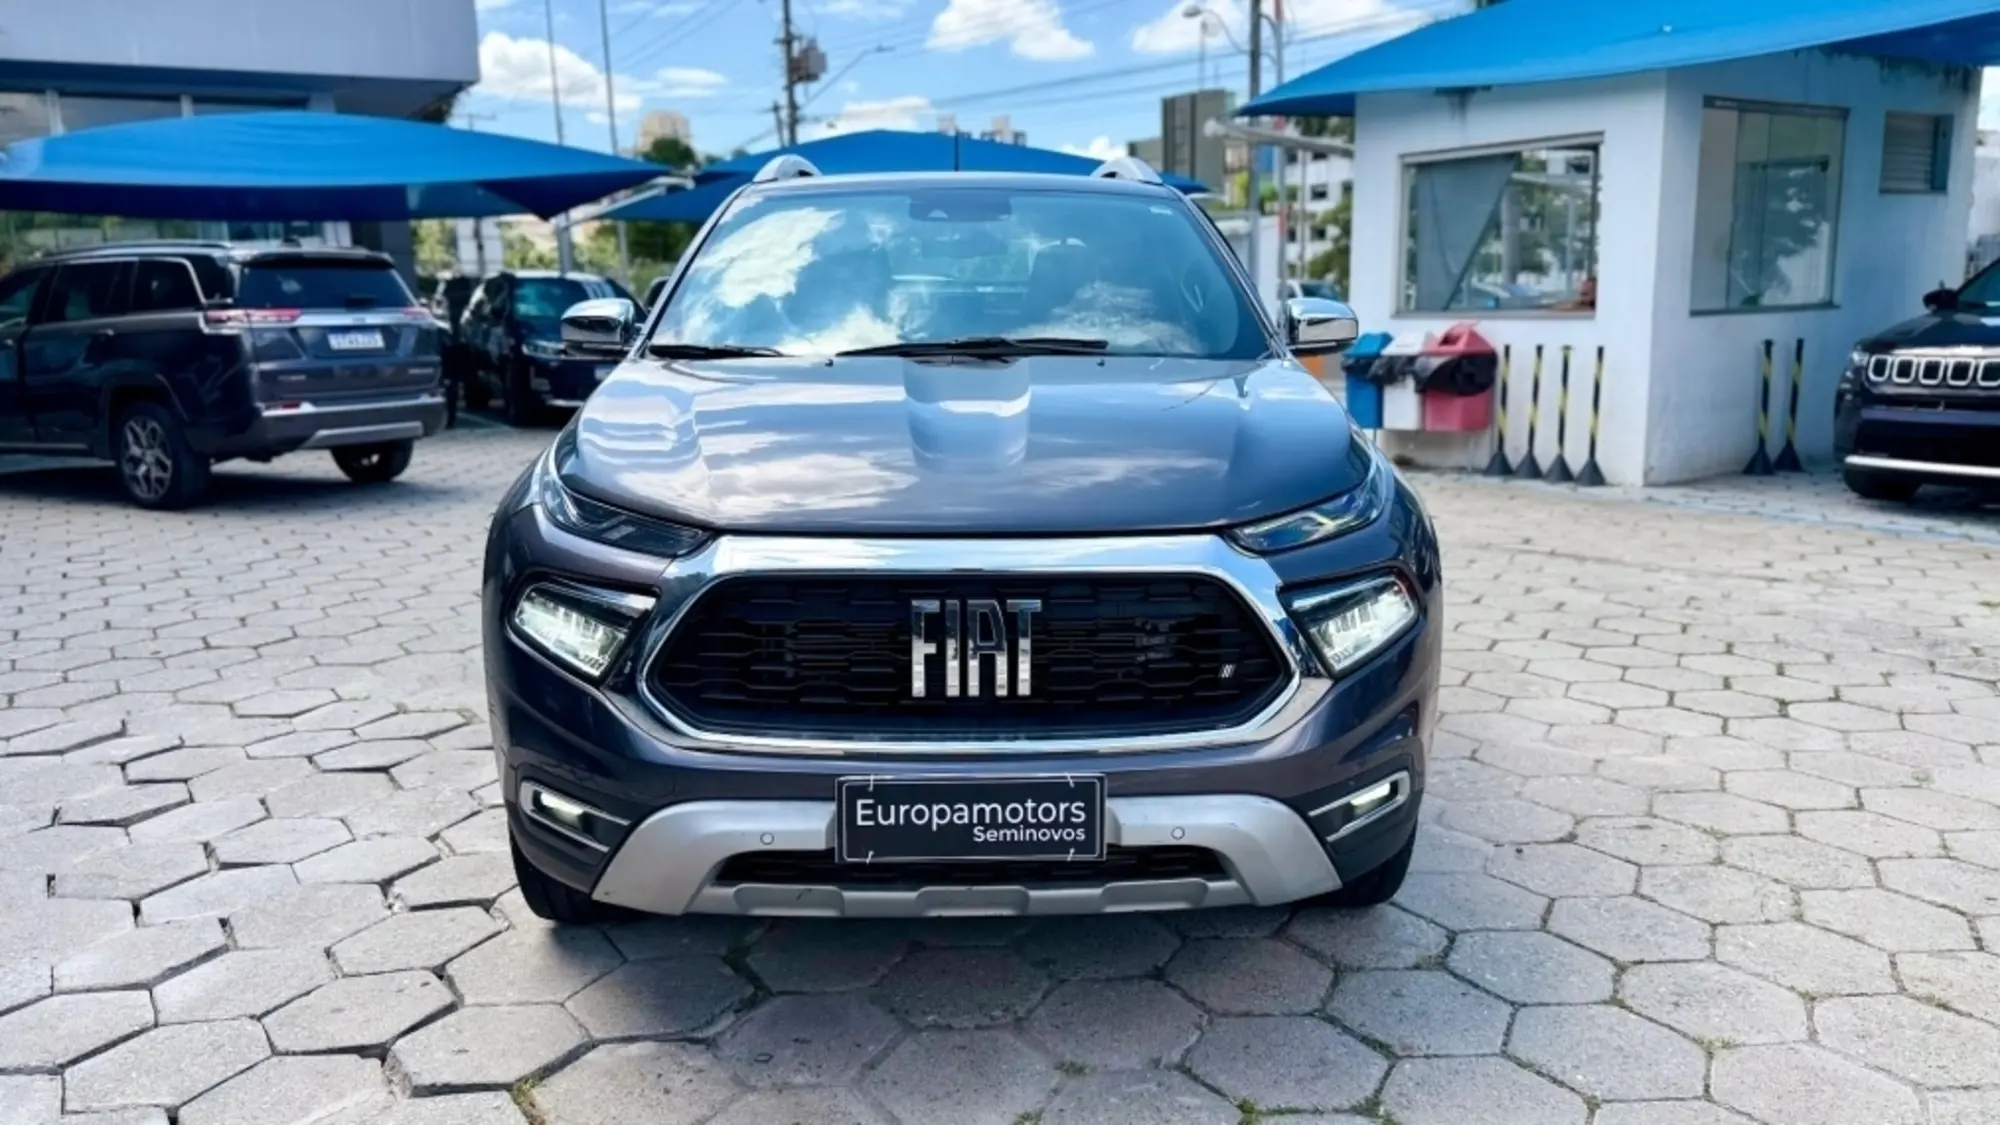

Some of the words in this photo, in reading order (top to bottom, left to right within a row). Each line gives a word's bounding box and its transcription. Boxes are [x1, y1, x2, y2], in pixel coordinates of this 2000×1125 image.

[911, 599, 1042, 697] FIAT
[856, 798, 1086, 832] Europamotors
[973, 825, 1086, 842] Seminovos
